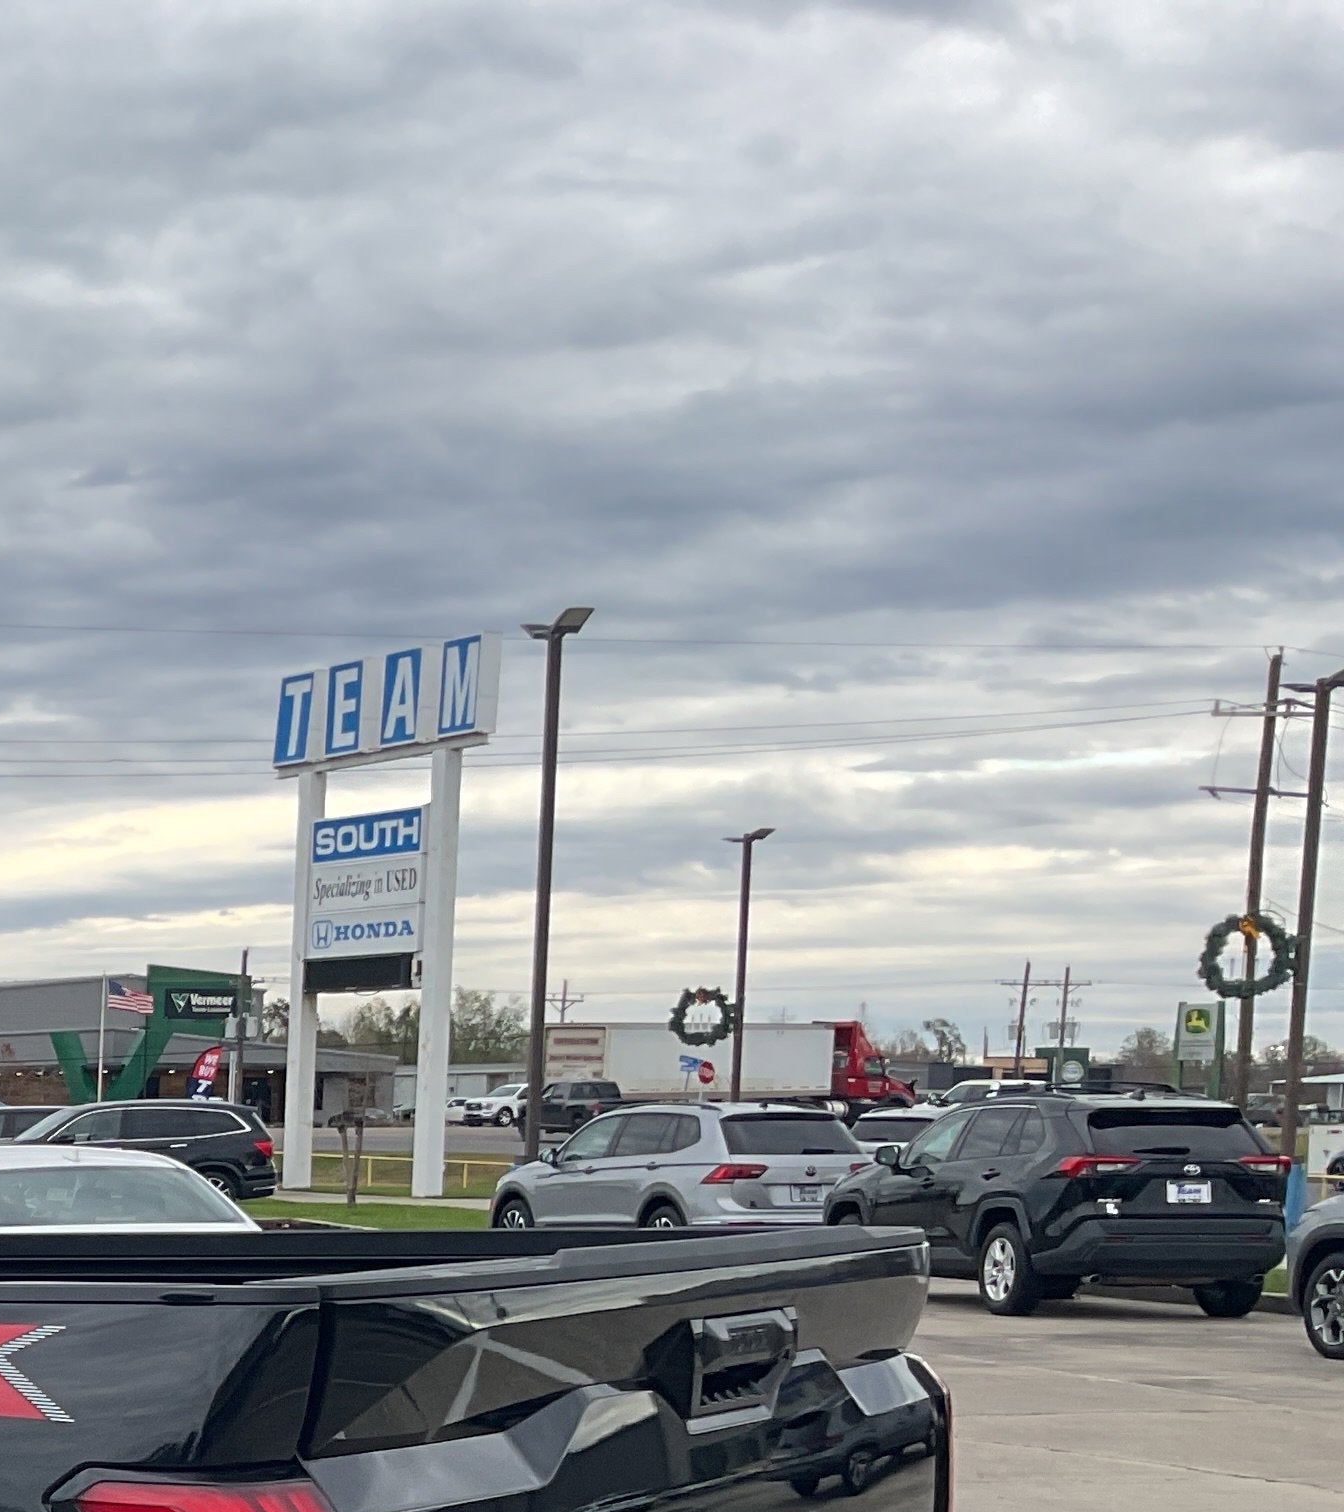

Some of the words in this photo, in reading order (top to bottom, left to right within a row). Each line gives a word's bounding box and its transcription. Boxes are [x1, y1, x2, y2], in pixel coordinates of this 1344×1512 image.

[284, 640, 481, 757] TEAM
[315, 815, 419, 856] SOUTH
[313, 873, 372, 905] Specializing
[373, 871, 384, 894] in
[386, 867, 417, 892] USED
[334, 919, 414, 942] HONDA
[189, 993, 234, 1006] Vermeer
